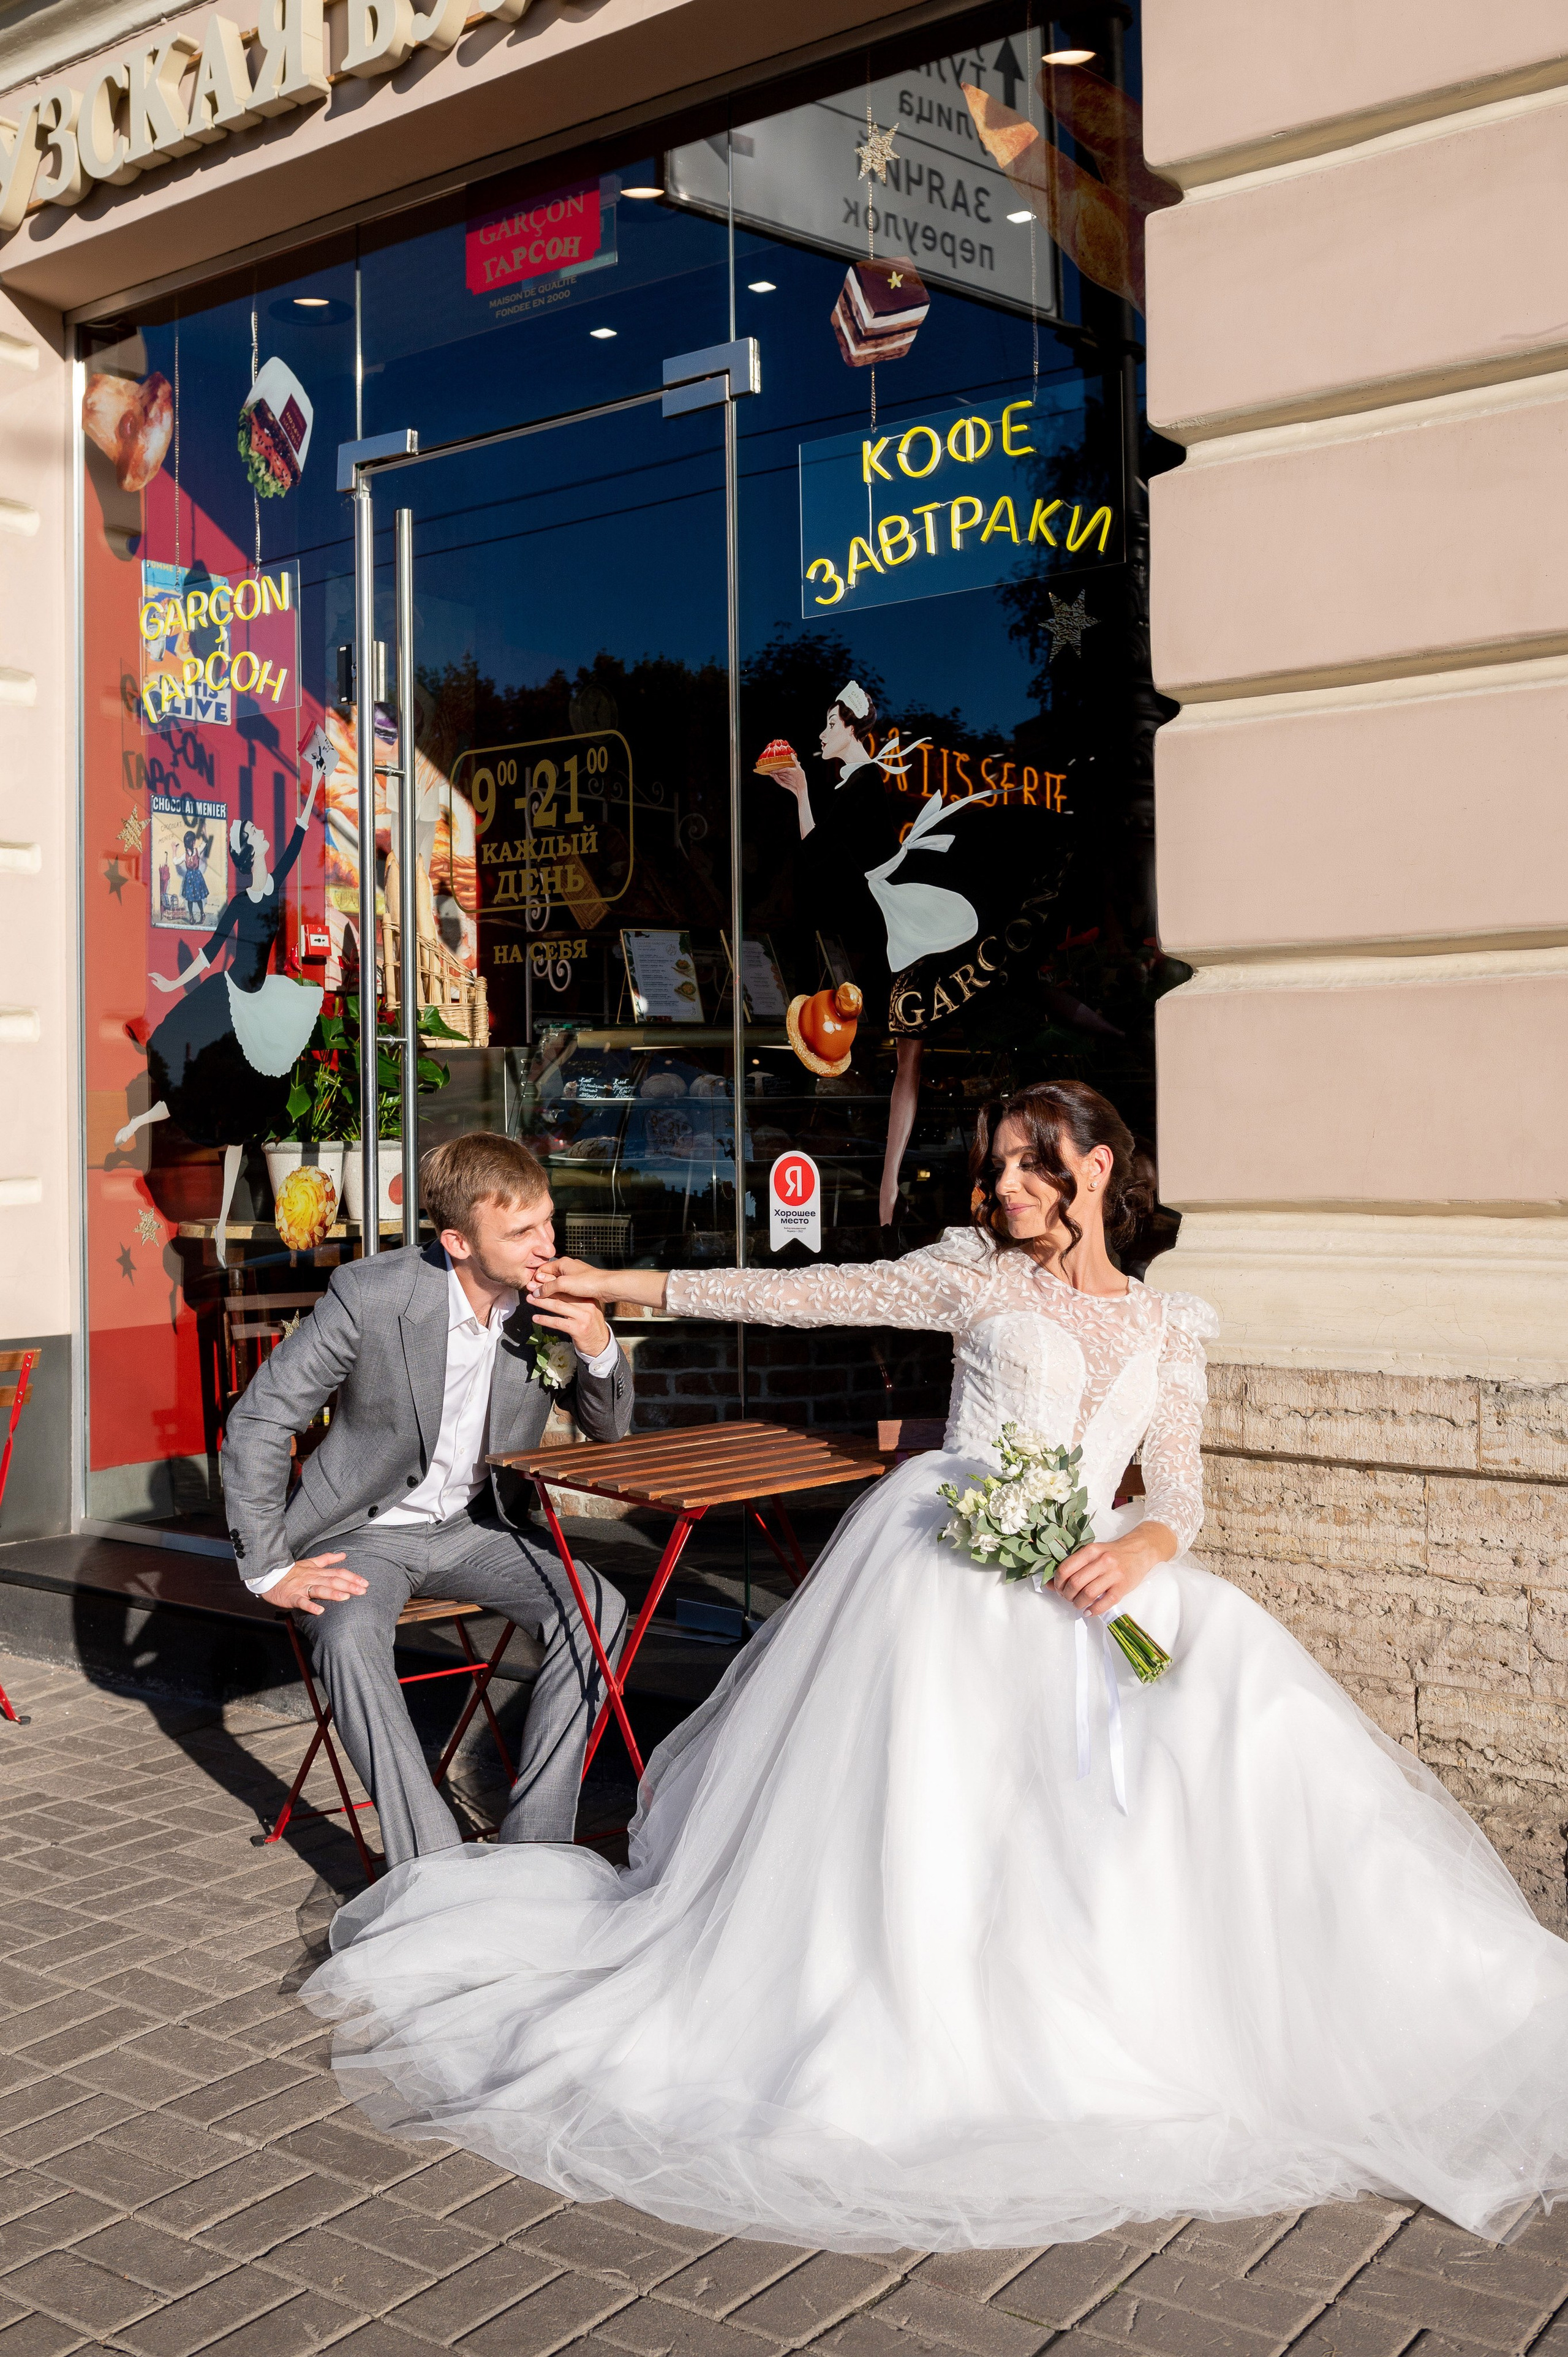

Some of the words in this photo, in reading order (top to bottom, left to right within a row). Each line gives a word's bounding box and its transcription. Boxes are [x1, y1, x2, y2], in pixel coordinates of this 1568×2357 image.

[479, 190, 585, 245] GARÇON
[483, 236, 582, 283] ГАРСОН
[489, 291, 522, 308] MAISON
[524, 287, 537, 298] DE
[532, 297, 546, 307] EN
[547, 289, 571, 303] 2000
[862, 400, 1036, 485] КОФЕ
[805, 496, 1113, 606] ЗАВТРАКИ
[140, 571, 290, 644] GARÇON
[141, 651, 288, 724] ГАРСОН
[153, 796, 194, 814] CHOCOLAT
[196, 801, 226, 818] MENIER
[481, 824, 598, 865] КАЖДЫЙ
[493, 864, 585, 905] ДЕНЬ
[494, 944, 523, 965] НА
[529, 939, 588, 961] СЕБЯ
[785, 1165, 803, 1197] Я
[774, 1209, 816, 1218] Хорошее
